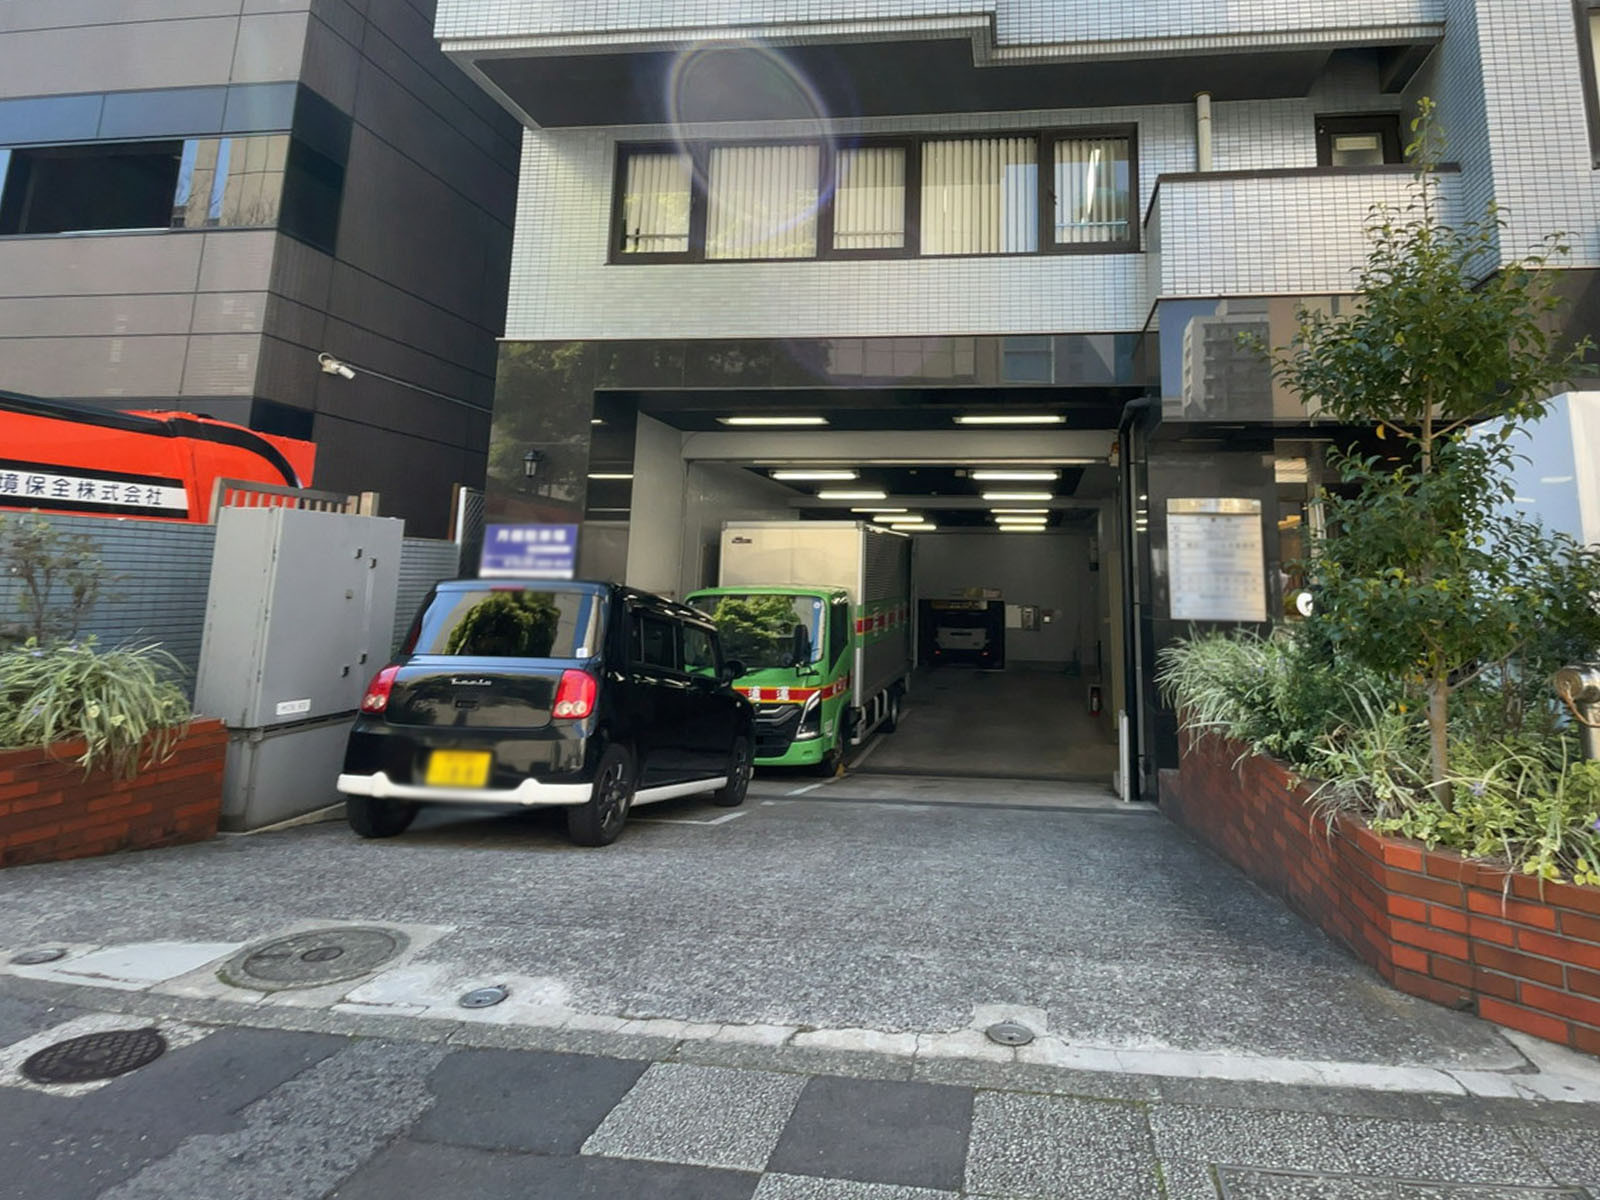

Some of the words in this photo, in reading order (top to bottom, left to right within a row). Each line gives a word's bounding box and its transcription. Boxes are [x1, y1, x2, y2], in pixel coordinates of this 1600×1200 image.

[0, 473, 163, 506] 境保全株式会社
